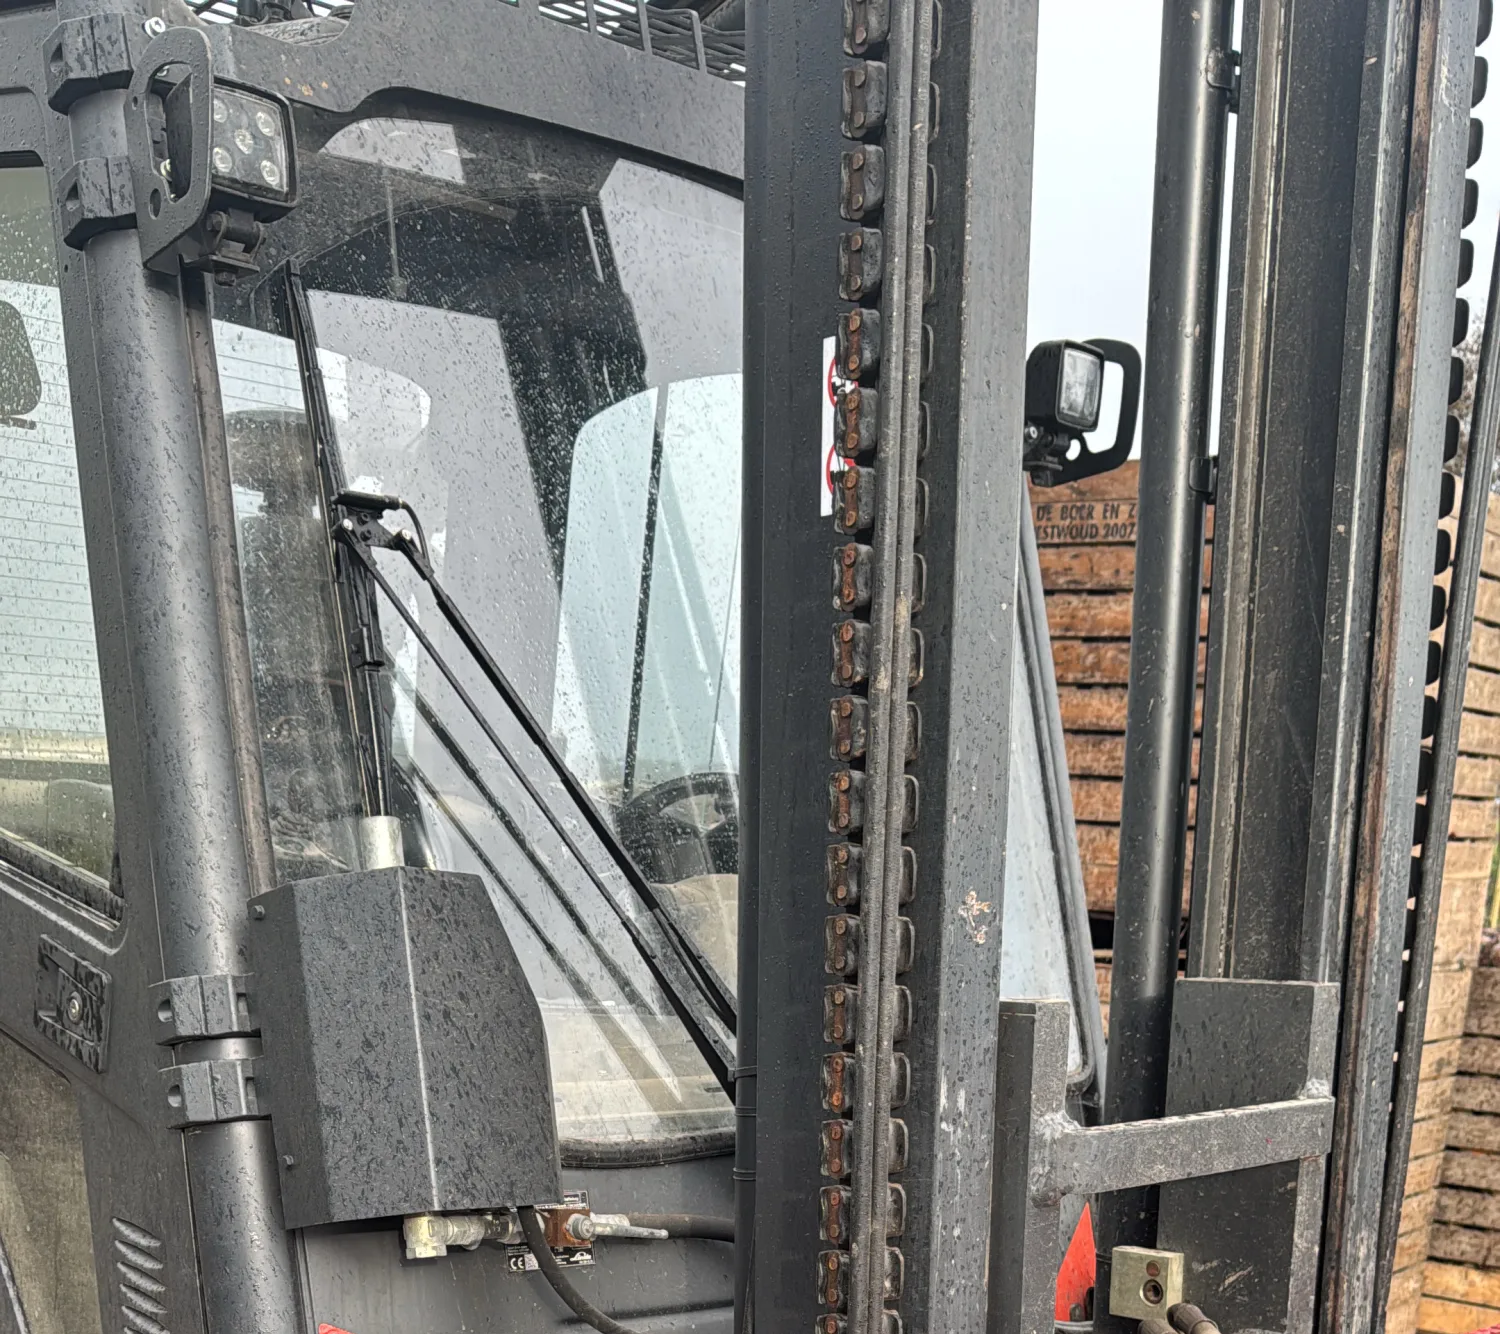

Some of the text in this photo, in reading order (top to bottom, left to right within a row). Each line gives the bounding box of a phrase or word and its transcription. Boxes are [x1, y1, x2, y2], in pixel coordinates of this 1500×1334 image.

[1037, 505, 1052, 522] DE
[1103, 503, 1120, 520] EN
[1103, 523, 1136, 539] 2007
